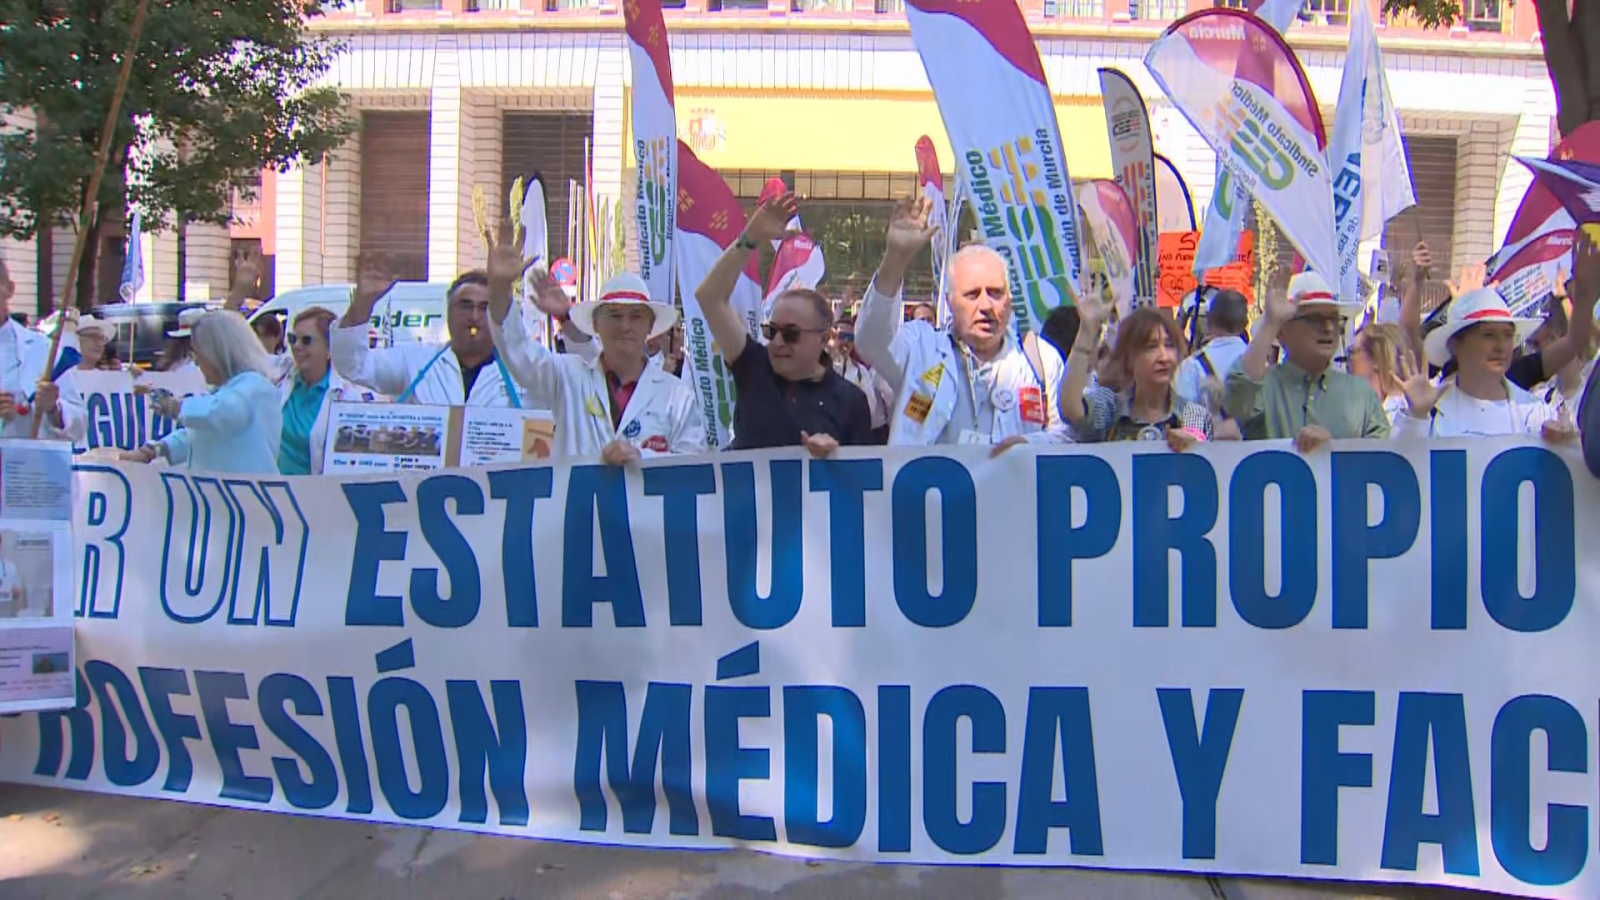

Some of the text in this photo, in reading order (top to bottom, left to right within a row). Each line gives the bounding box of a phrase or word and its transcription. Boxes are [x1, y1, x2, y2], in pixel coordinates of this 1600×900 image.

[966, 149, 1007, 239] Médico
[1036, 128, 1062, 191] Murcia
[637, 204, 650, 281] Sindicato
[1054, 194, 1070, 216] de
[692, 317, 720, 447] Sindicato Médico
[160, 471, 310, 628] UN
[341, 455, 978, 631] ESTATUTO
[1036, 446, 1576, 632] PROPIO
[33, 638, 1600, 886] ROFESIÓN MÉDICA Y FAC
